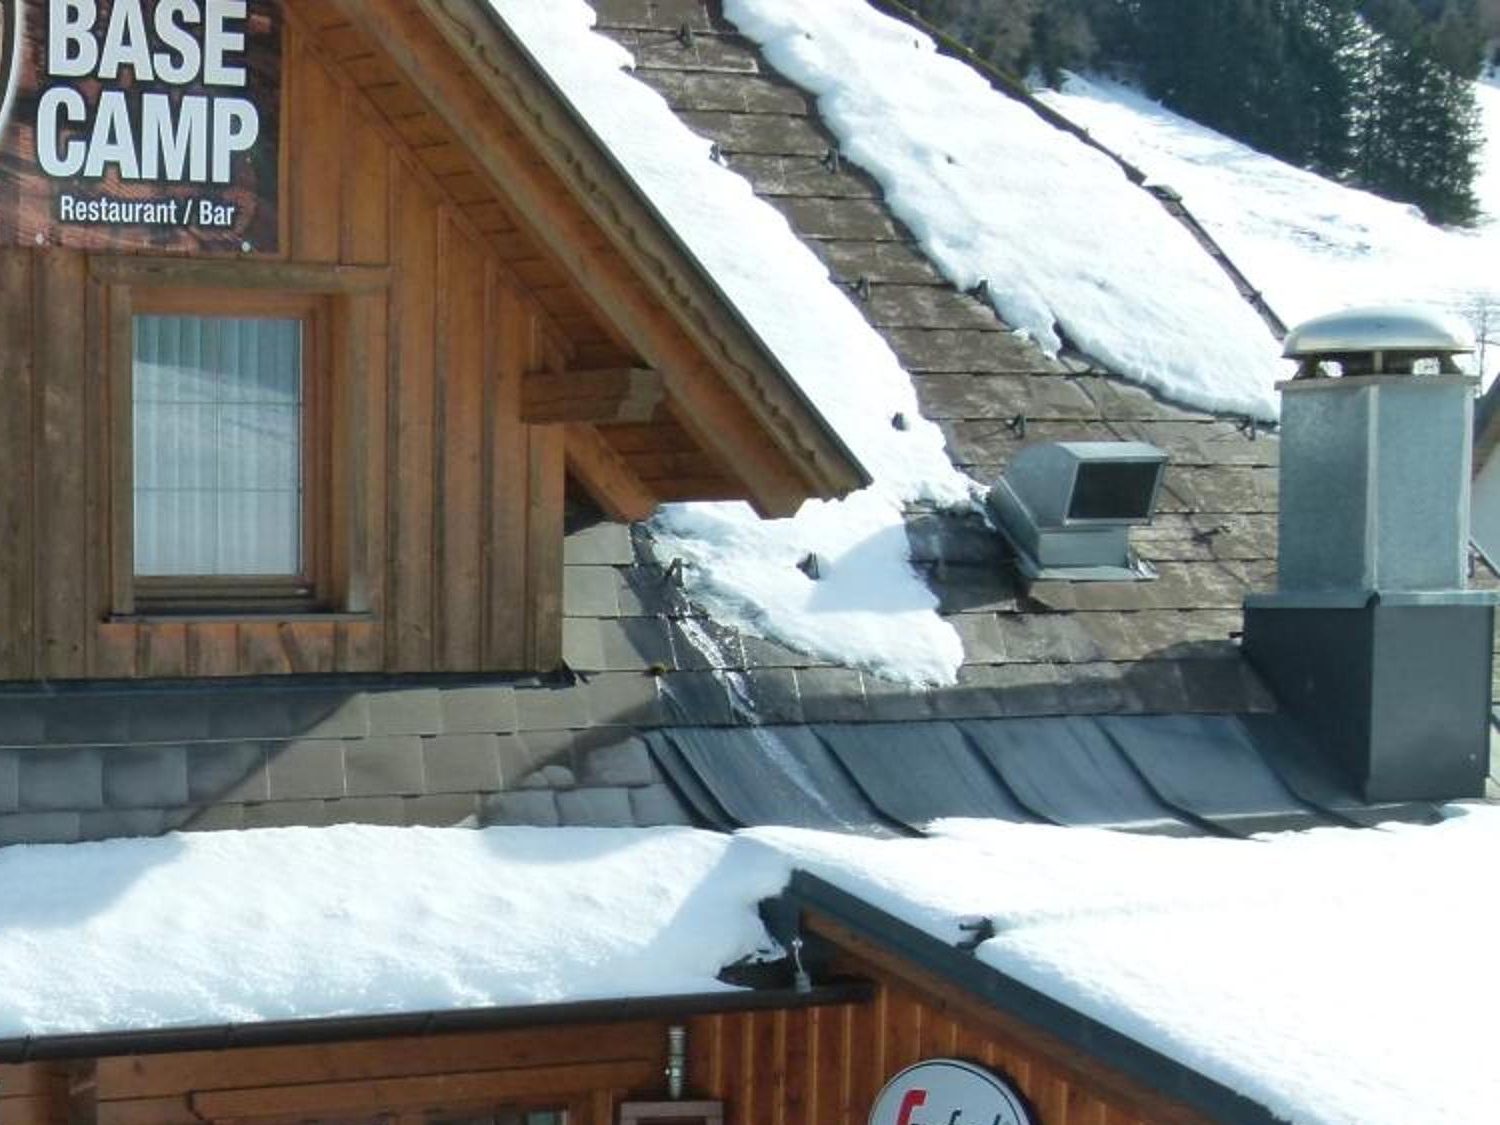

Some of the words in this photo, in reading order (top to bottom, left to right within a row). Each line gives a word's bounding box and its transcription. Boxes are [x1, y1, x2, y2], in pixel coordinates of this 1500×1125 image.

[48, 0, 247, 86] BASE
[37, 87, 259, 183] CAMP
[61, 195, 177, 224] Restaurant
[199, 200, 235, 225] Bar
